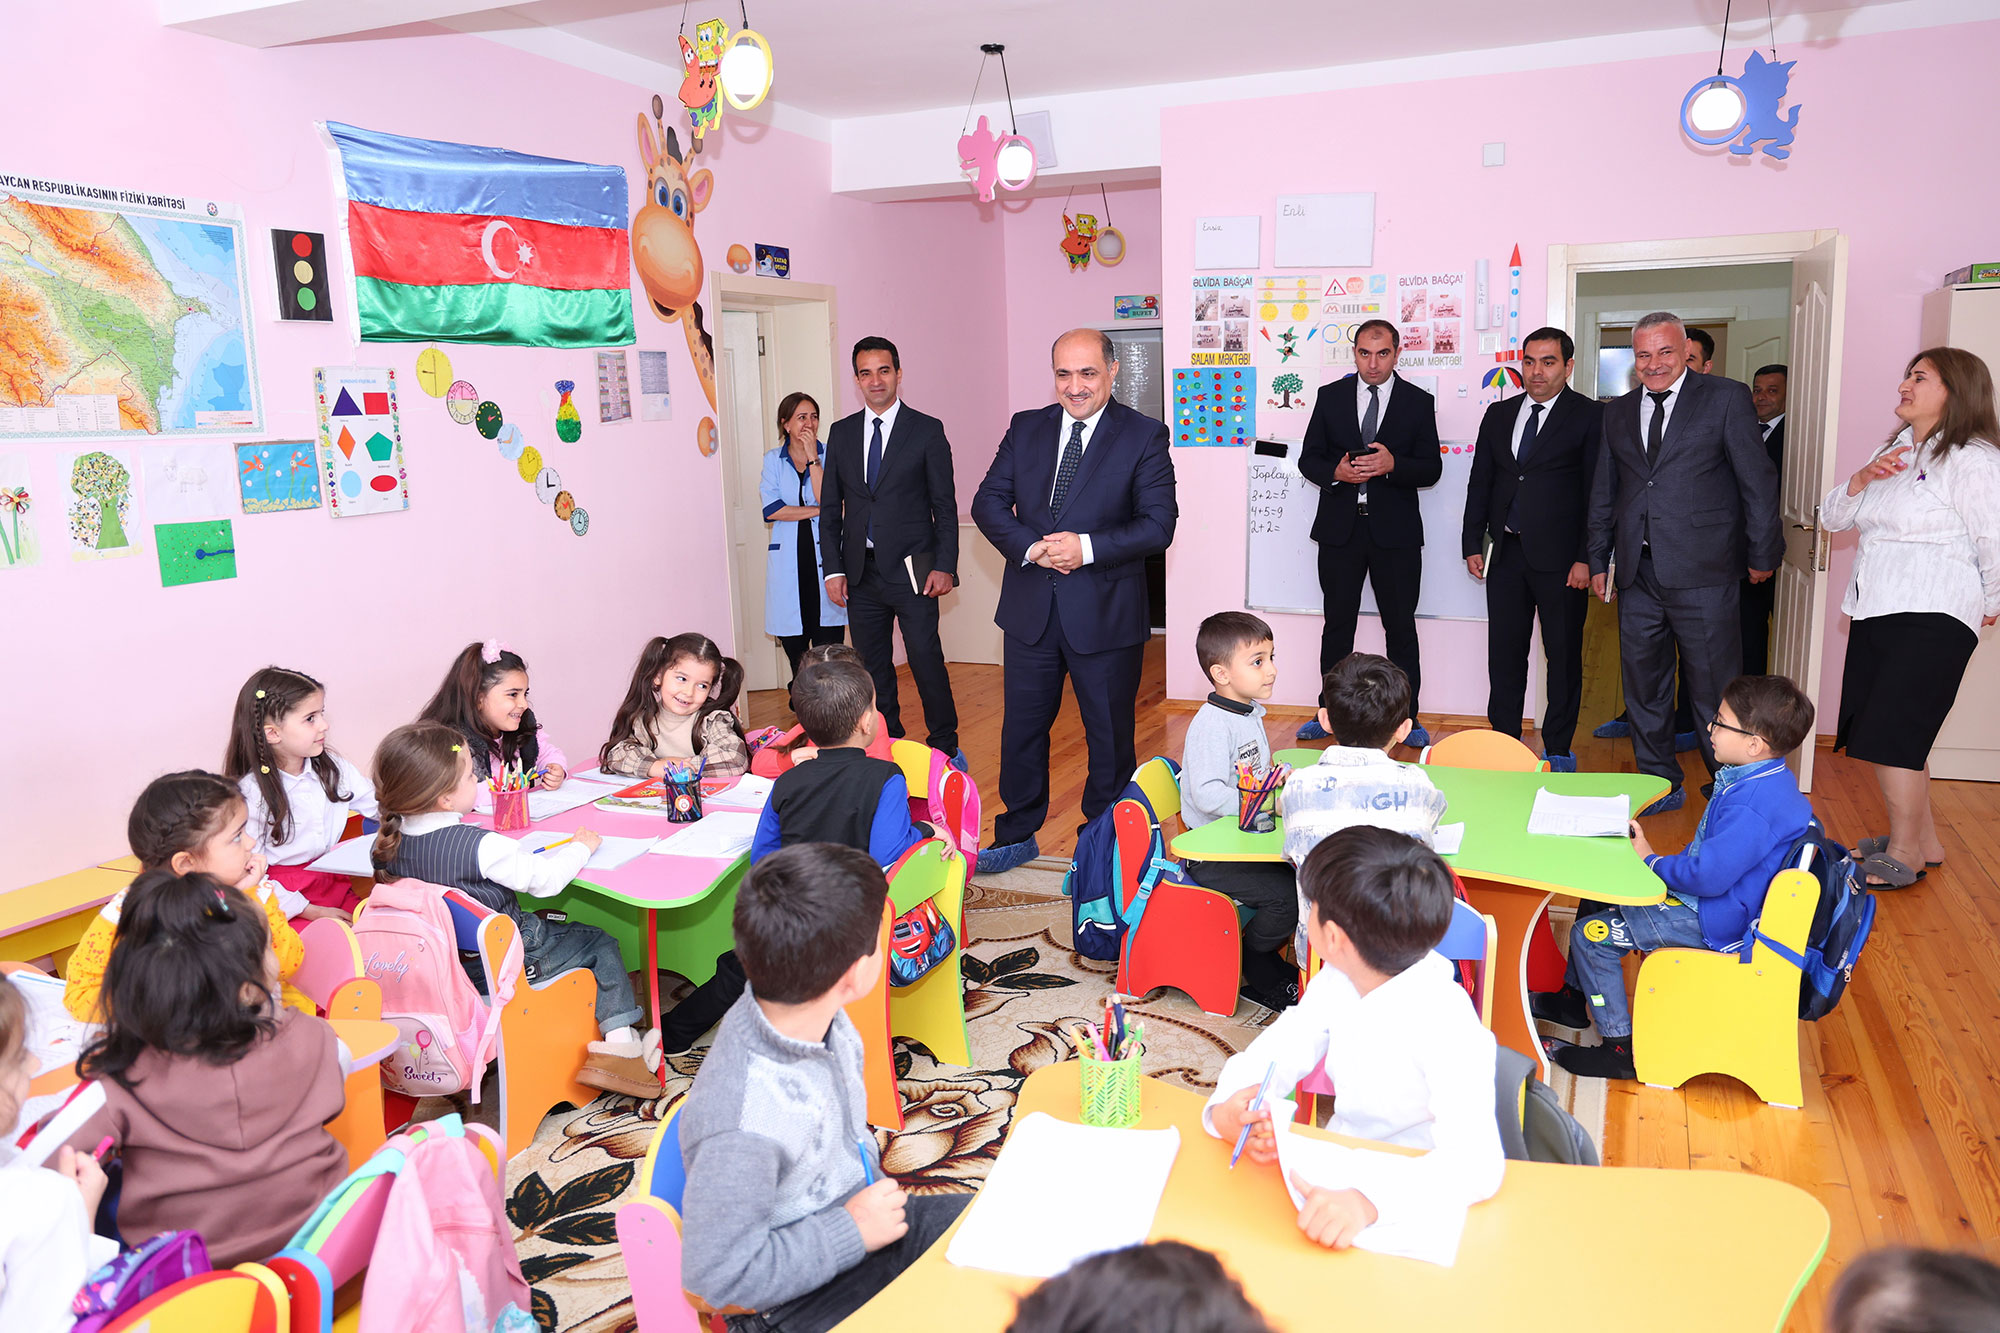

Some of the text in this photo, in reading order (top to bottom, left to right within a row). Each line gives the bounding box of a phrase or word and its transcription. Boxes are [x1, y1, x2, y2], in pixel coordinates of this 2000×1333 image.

[32, 180, 118, 201] RESPUBLİKASININ
[120, 191, 145, 204] FİZİKİ
[147, 195, 186, 210] XƏRİTƏSİ
[1193, 277, 1252, 288] ƏLVİDA BAĞÇA!
[1399, 273, 1463, 287] ƏLVİDA BAĞÇA!
[1191, 353, 1251, 365] SALAM MƏKTƏB!
[1400, 356, 1462, 367] SALAM MƏKTƏB!
[364, 950, 408, 983] Lovely
[404, 1066, 447, 1083] Sweet
